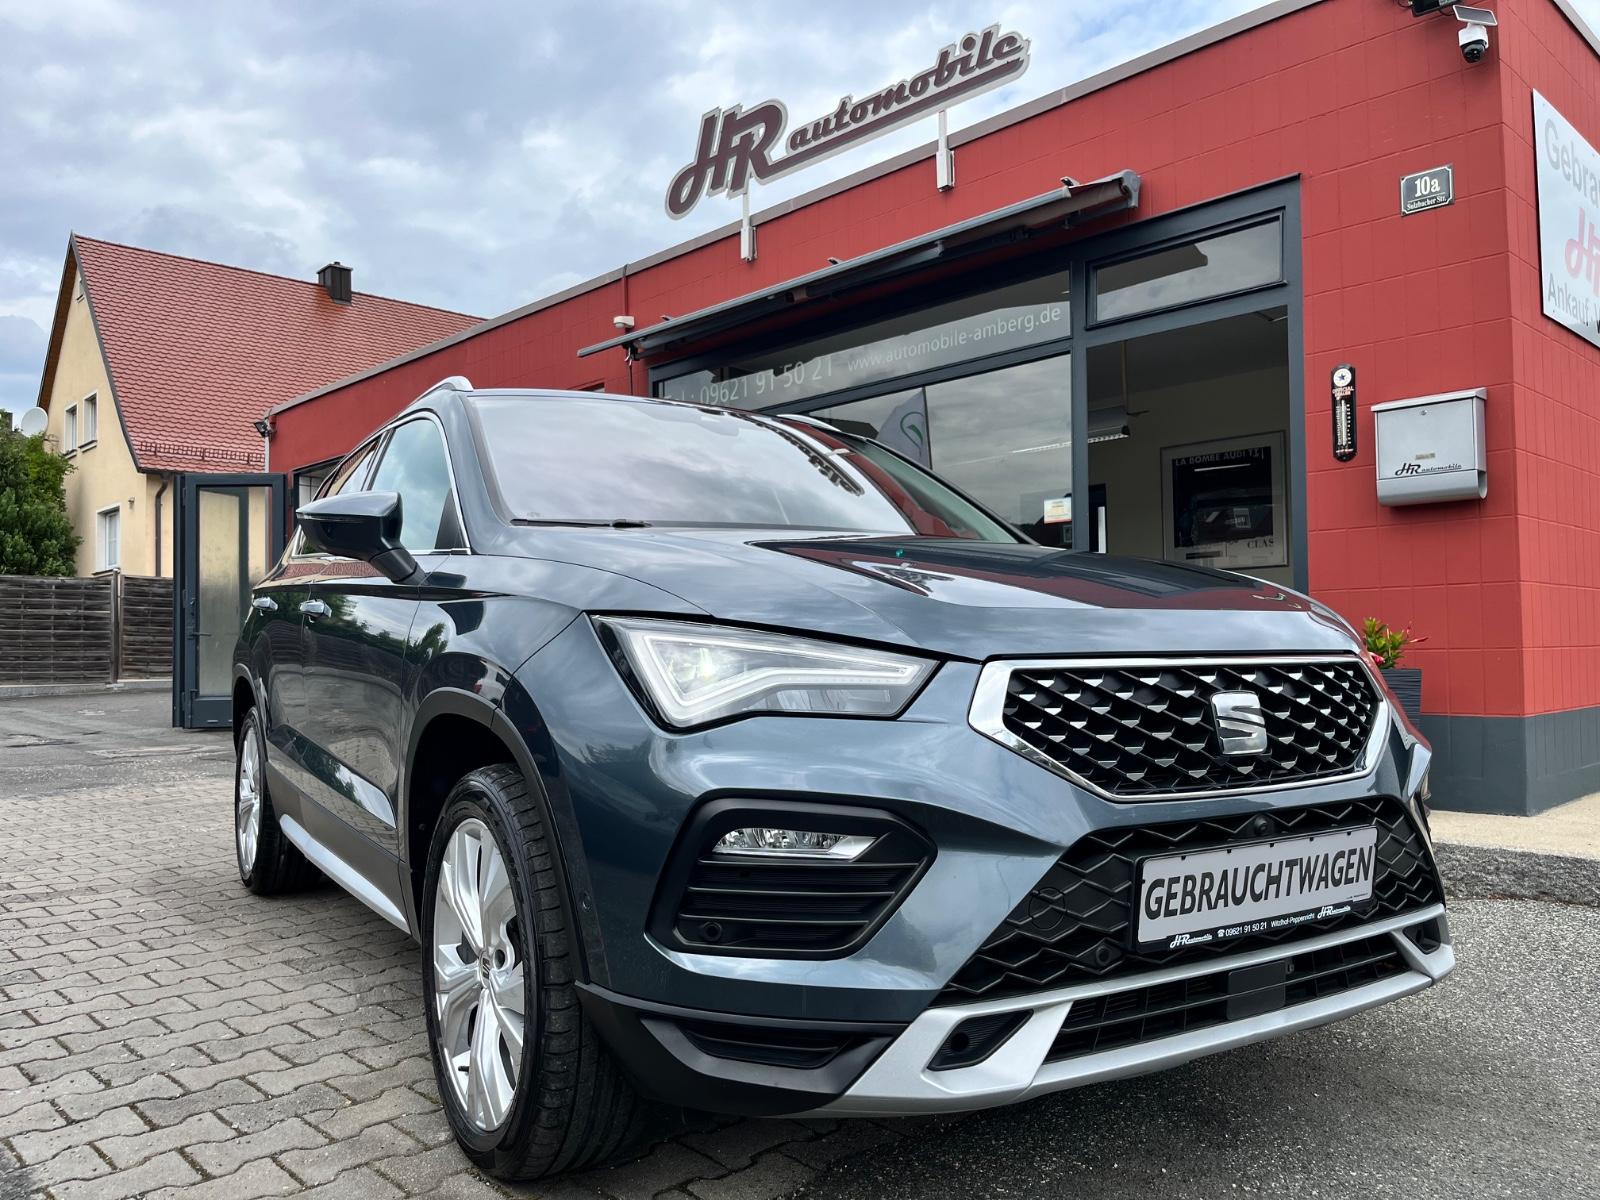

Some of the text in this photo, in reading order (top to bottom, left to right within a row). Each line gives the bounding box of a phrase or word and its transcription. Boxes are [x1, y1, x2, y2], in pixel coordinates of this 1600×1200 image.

[667, 26, 1025, 216] HR automobile
[1414, 176, 1440, 197] 10a
[1545, 118, 1600, 208] Gebra
[1436, 195, 1447, 204] Str.
[701, 374, 748, 405] 09621
[756, 368, 774, 394] 91
[783, 361, 804, 388] 50
[812, 355, 832, 380] 21
[847, 305, 1061, 371] www.automobile-amberg.de
[1395, 463, 1421, 476] HR
[1144, 845, 1373, 920] GEBRAUCHTWAGEN
[1225, 928, 1243, 936] 09621
[1244, 925, 1251, 933] 91
[1252, 923, 1260, 931] 50
[1260, 921, 1267, 930] 21
